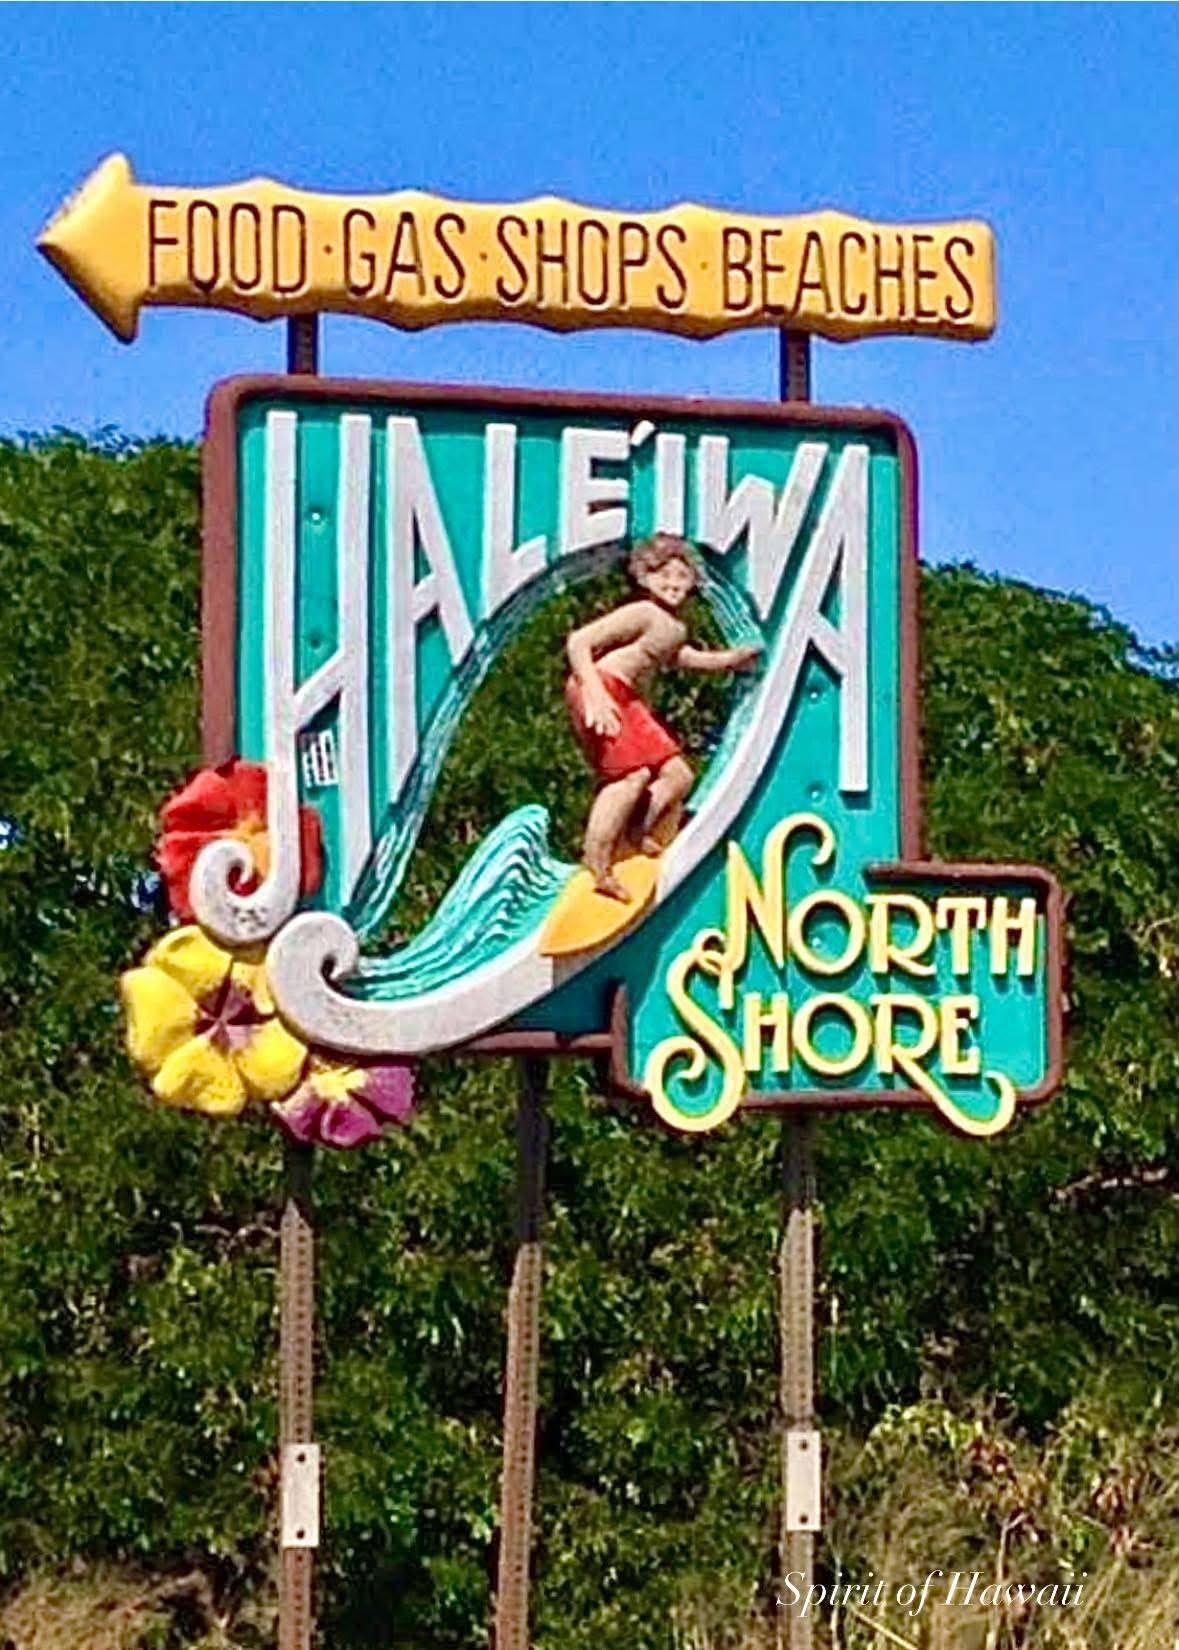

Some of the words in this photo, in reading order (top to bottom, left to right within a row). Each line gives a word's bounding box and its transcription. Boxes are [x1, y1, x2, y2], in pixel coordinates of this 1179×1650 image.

[148, 199, 307, 296] FOOD
[342, 209, 467, 299] GAS
[496, 215, 687, 310] SHOPS
[721, 227, 976, 320] BEACHES
[693, 812, 1037, 976] NORTH
[644, 945, 1016, 1137] SHORE
